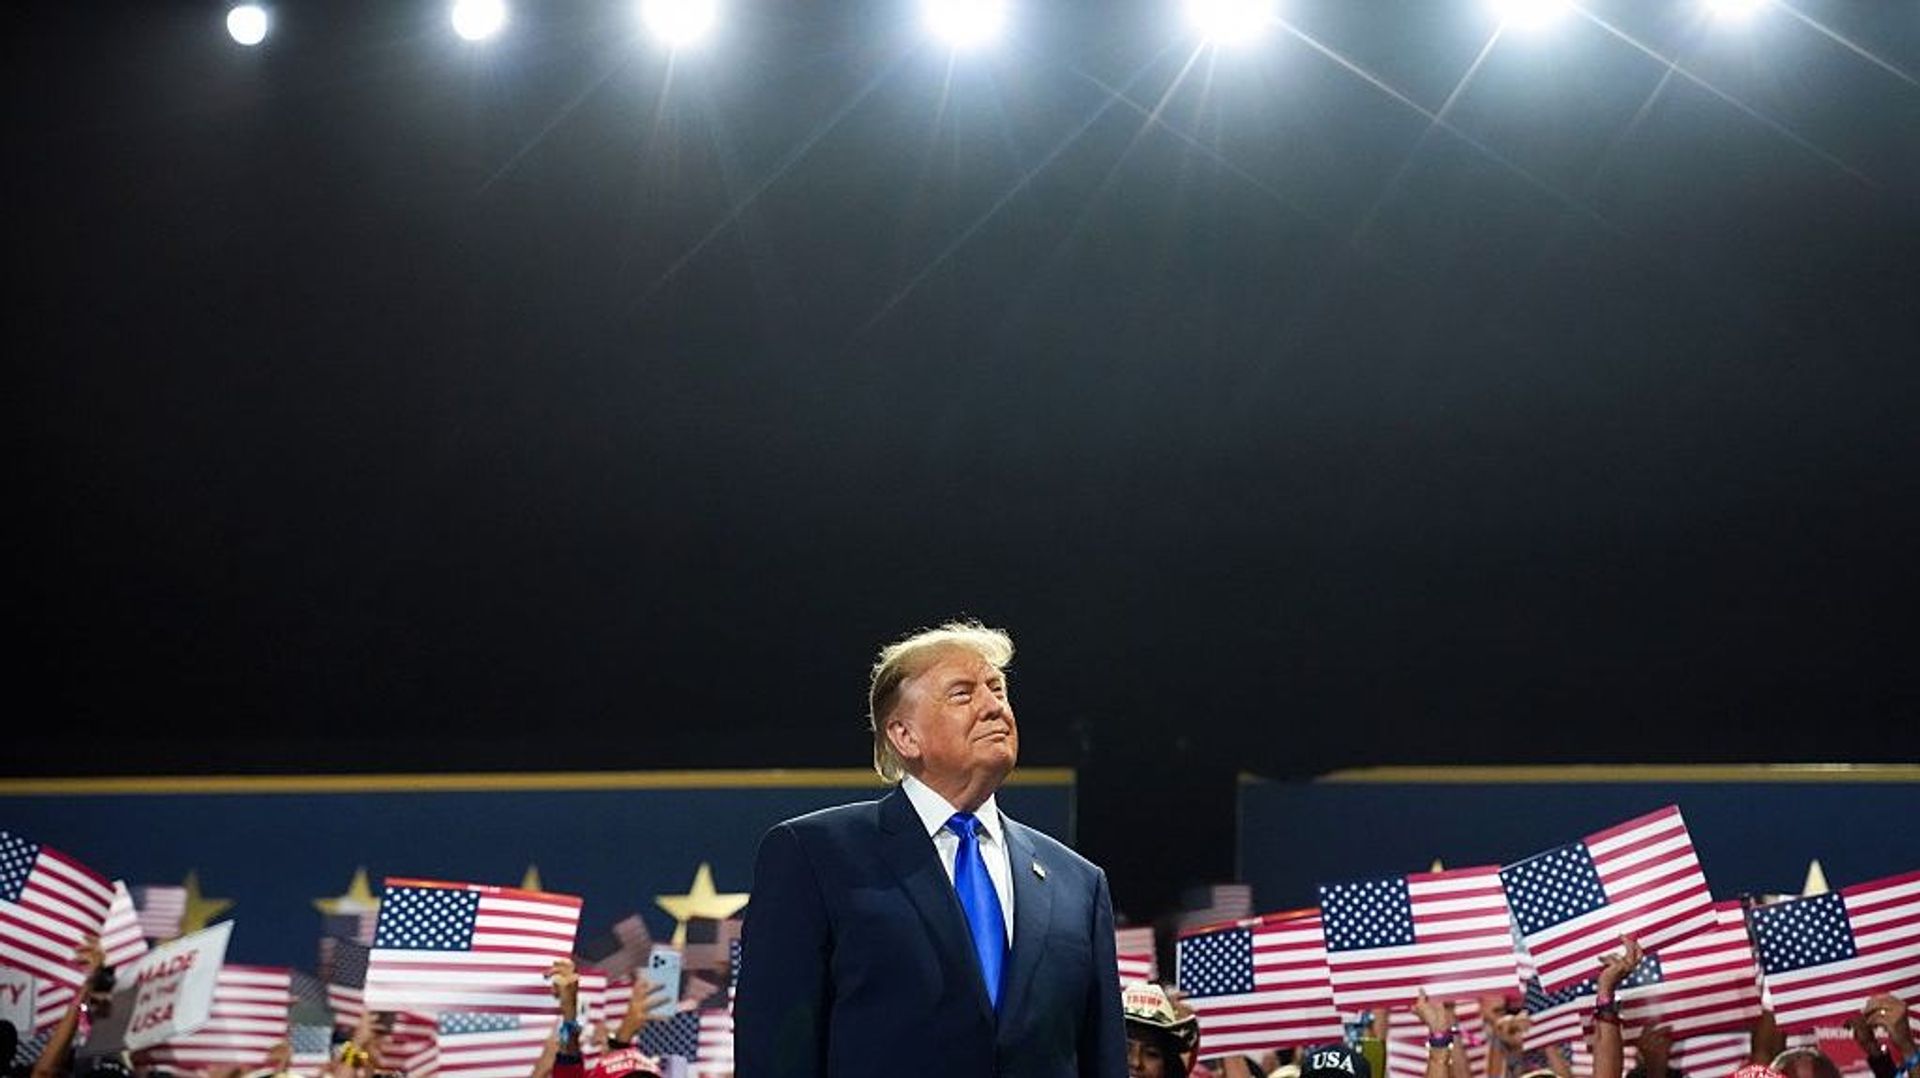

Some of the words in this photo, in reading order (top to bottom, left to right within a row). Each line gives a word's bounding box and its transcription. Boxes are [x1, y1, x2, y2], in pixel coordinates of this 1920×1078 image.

[136, 949, 199, 988] MADE
[1127, 994, 1162, 1007] TRUMP
[131, 1002, 174, 1033] USA
[1312, 1051, 1355, 1074] USA
